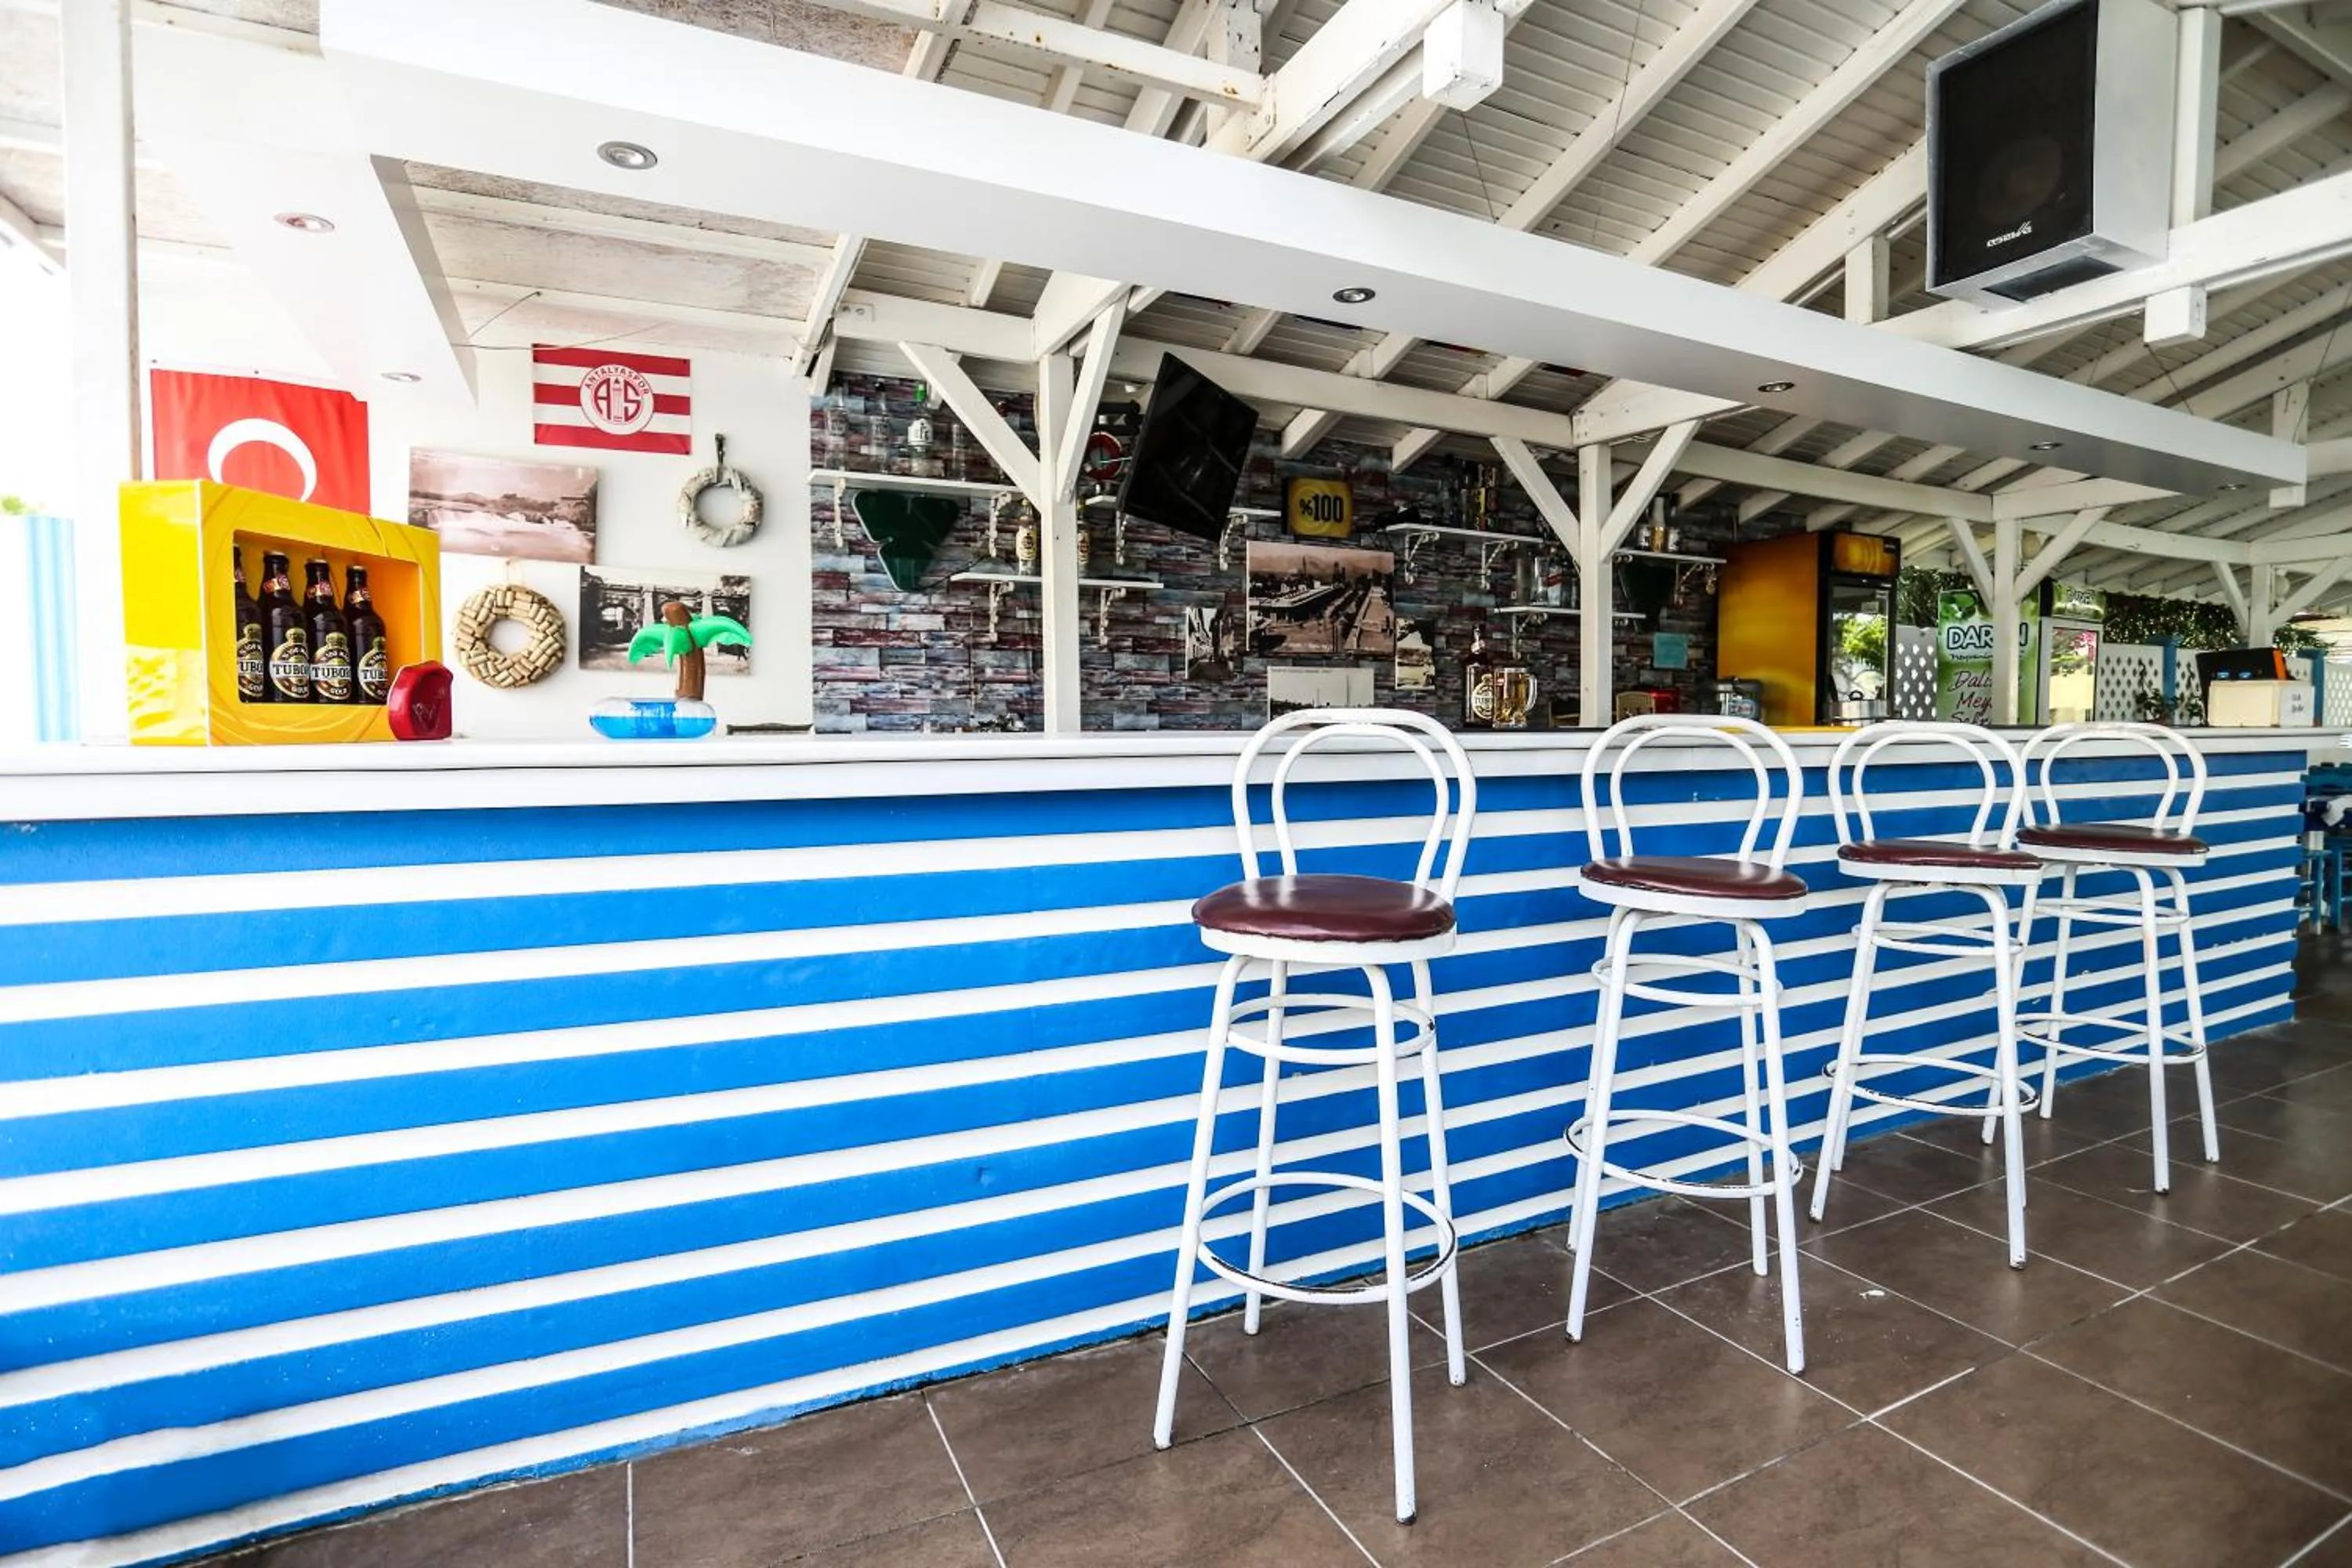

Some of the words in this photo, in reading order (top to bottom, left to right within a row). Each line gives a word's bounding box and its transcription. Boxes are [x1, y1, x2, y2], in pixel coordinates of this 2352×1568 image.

[585, 366, 650, 394] ANTALYASPOR
[1299, 493, 1344, 524] %100
[1947, 622, 2029, 650] DAR
